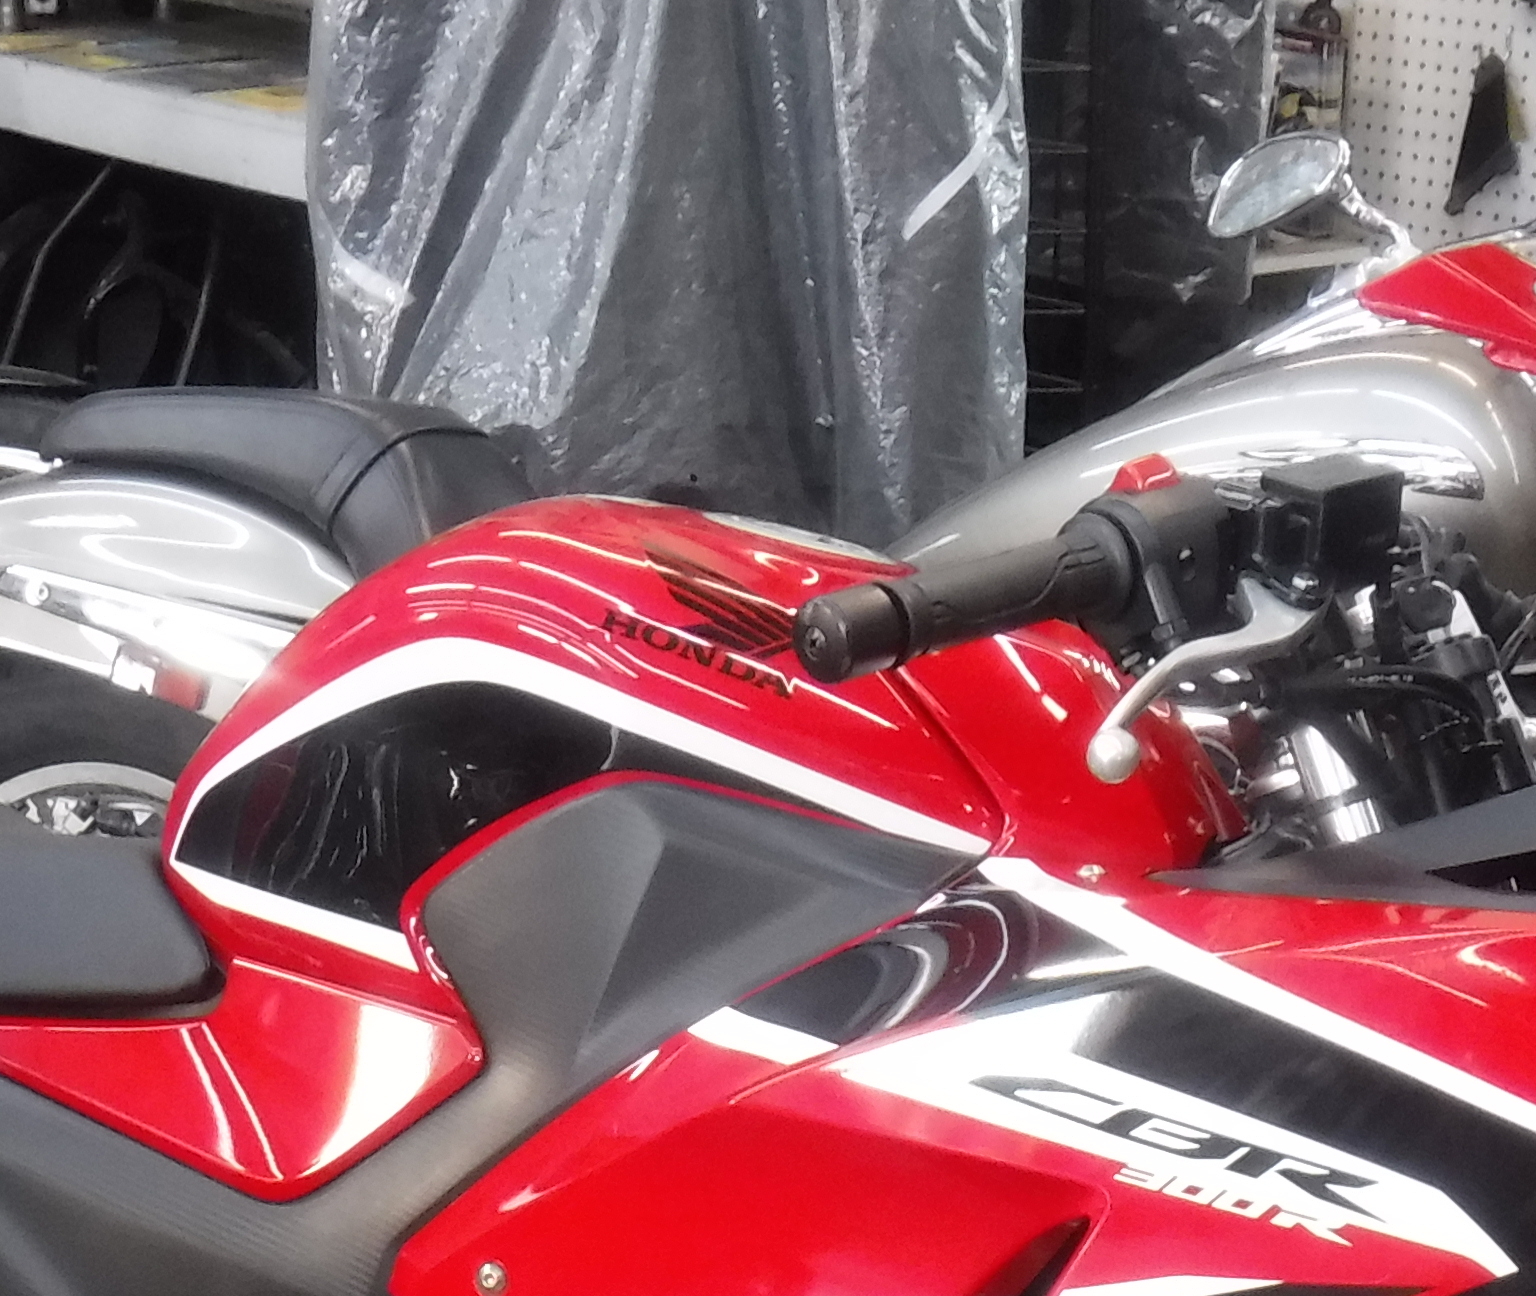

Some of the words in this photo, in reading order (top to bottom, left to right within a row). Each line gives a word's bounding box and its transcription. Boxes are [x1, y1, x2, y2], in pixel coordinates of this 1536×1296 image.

[601, 608, 792, 699] HONDA
[968, 1075, 1386, 1223] CBR
[1113, 1162, 1354, 1246] 300R
